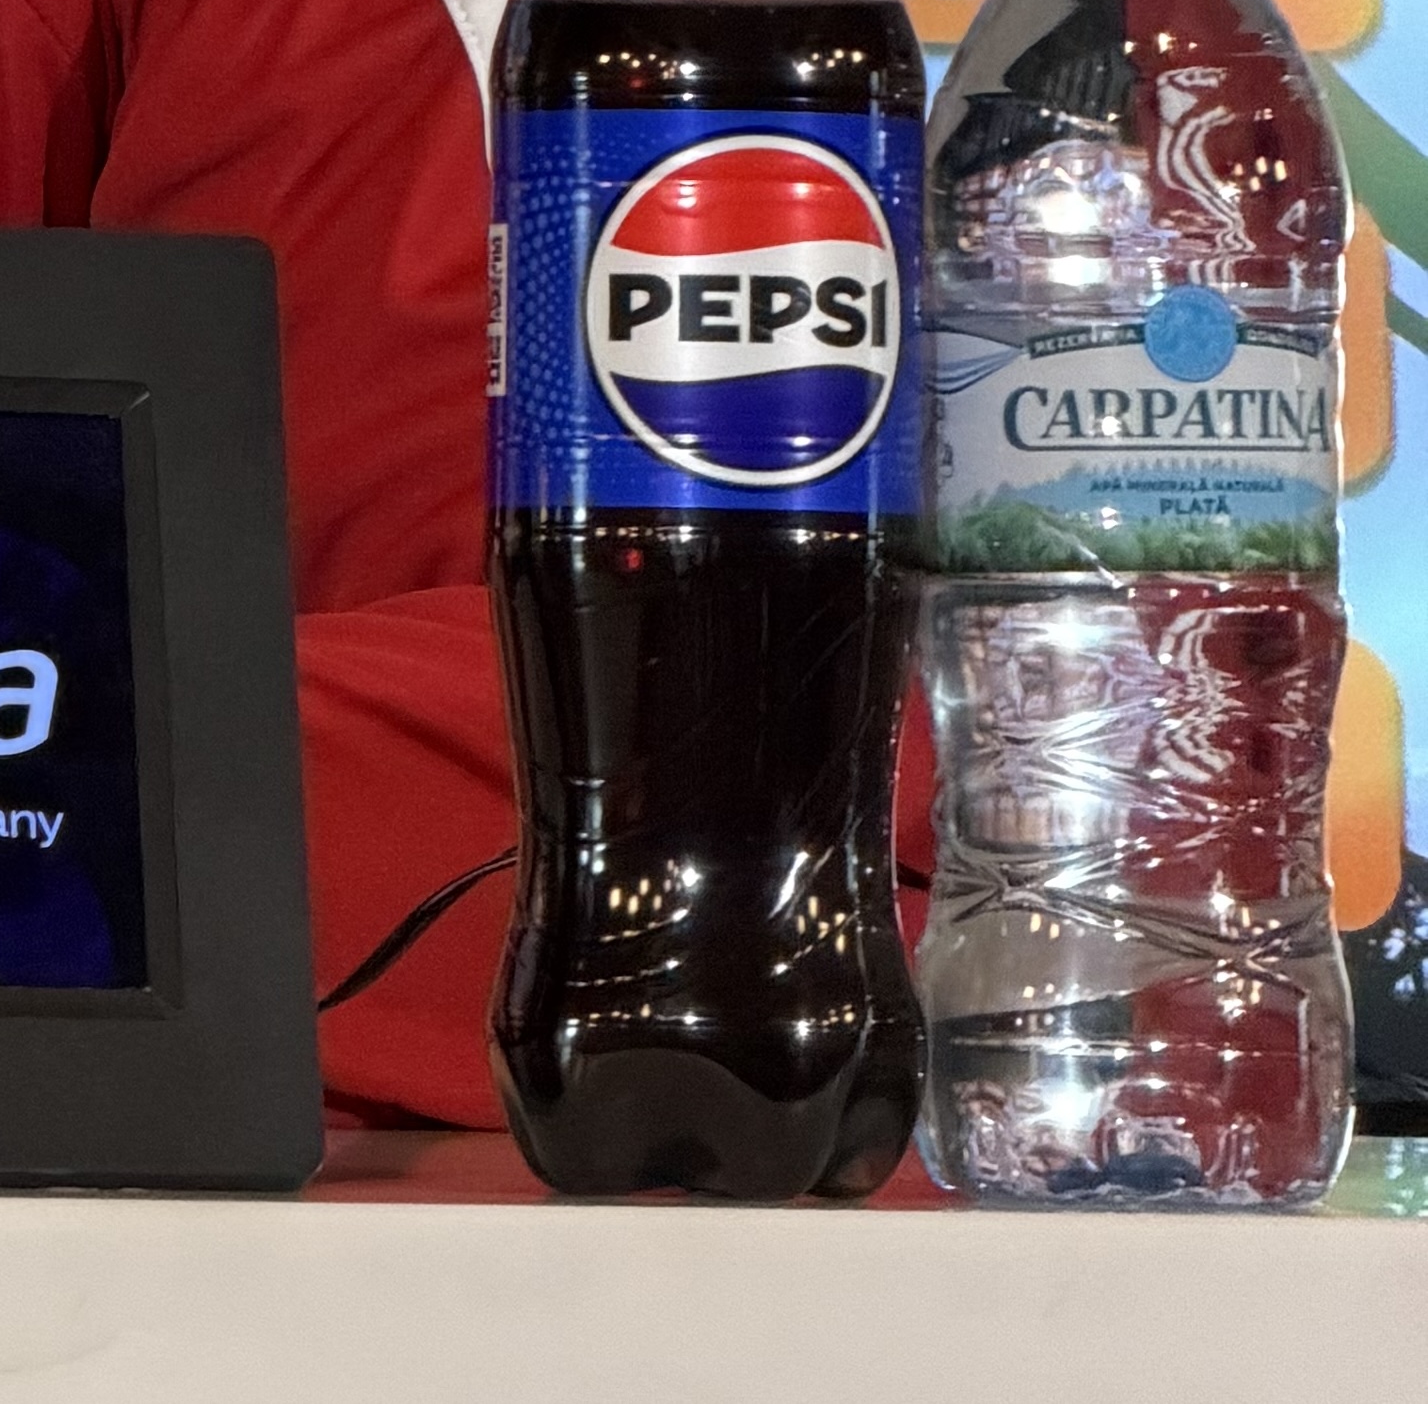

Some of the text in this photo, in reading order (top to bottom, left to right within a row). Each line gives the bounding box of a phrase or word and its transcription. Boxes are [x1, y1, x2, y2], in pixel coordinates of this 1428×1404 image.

[607, 272, 888, 348] PEPSI
[1002, 385, 1332, 454] CARPATINA
[1159, 496, 1231, 516] PLATĂ
